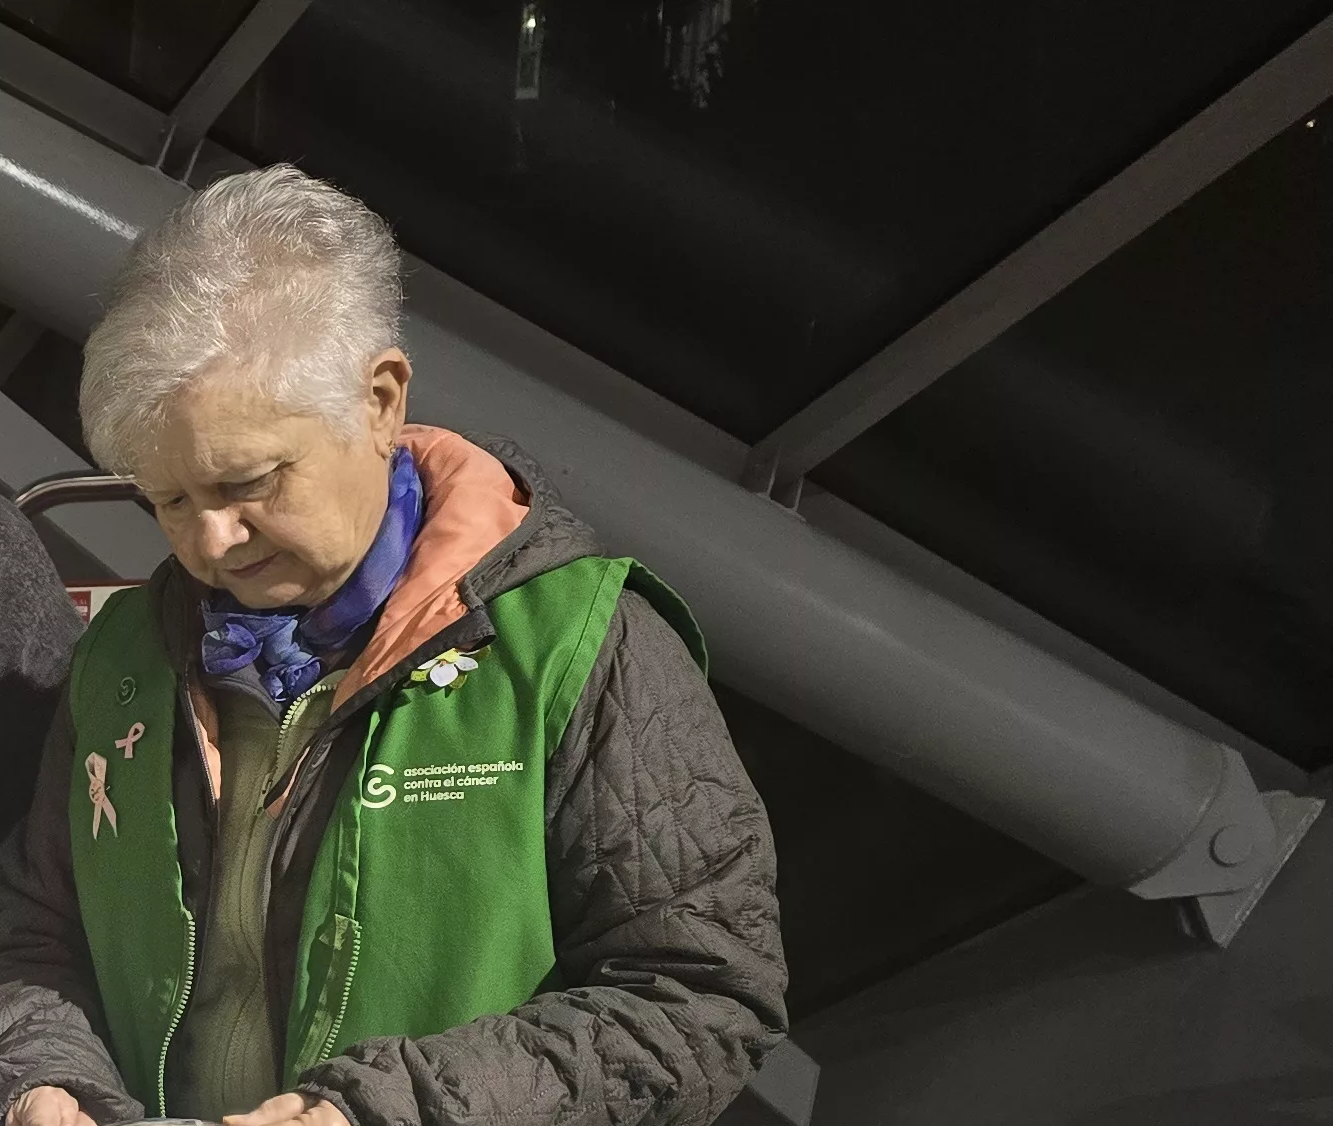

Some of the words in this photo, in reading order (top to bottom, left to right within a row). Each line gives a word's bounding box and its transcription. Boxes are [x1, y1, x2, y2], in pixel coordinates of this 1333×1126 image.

[403, 762, 465, 777] asociación
[467, 760, 523, 775] española
[403, 778, 442, 790] contra
[443, 776, 455, 787] el
[456, 775, 499, 787] cáncer
[403, 793, 418, 803] en
[420, 791, 465, 802] Huesca
